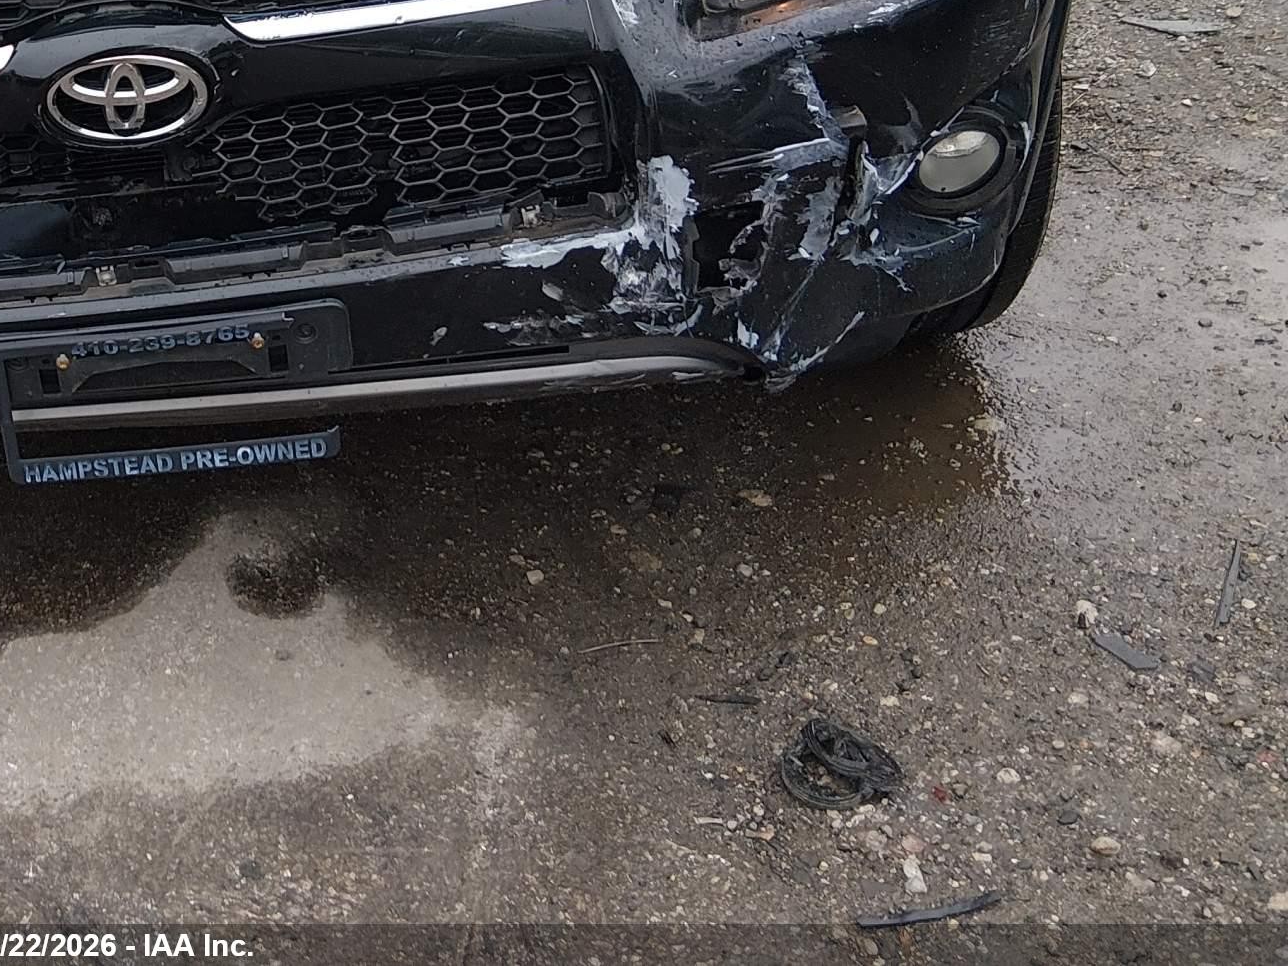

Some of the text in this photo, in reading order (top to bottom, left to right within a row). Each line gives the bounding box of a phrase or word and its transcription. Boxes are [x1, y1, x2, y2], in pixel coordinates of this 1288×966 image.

[71, 324, 250, 357] 410-239-8765
[24, 438, 328, 483] HAMPSTEAD PRE-OWNED
